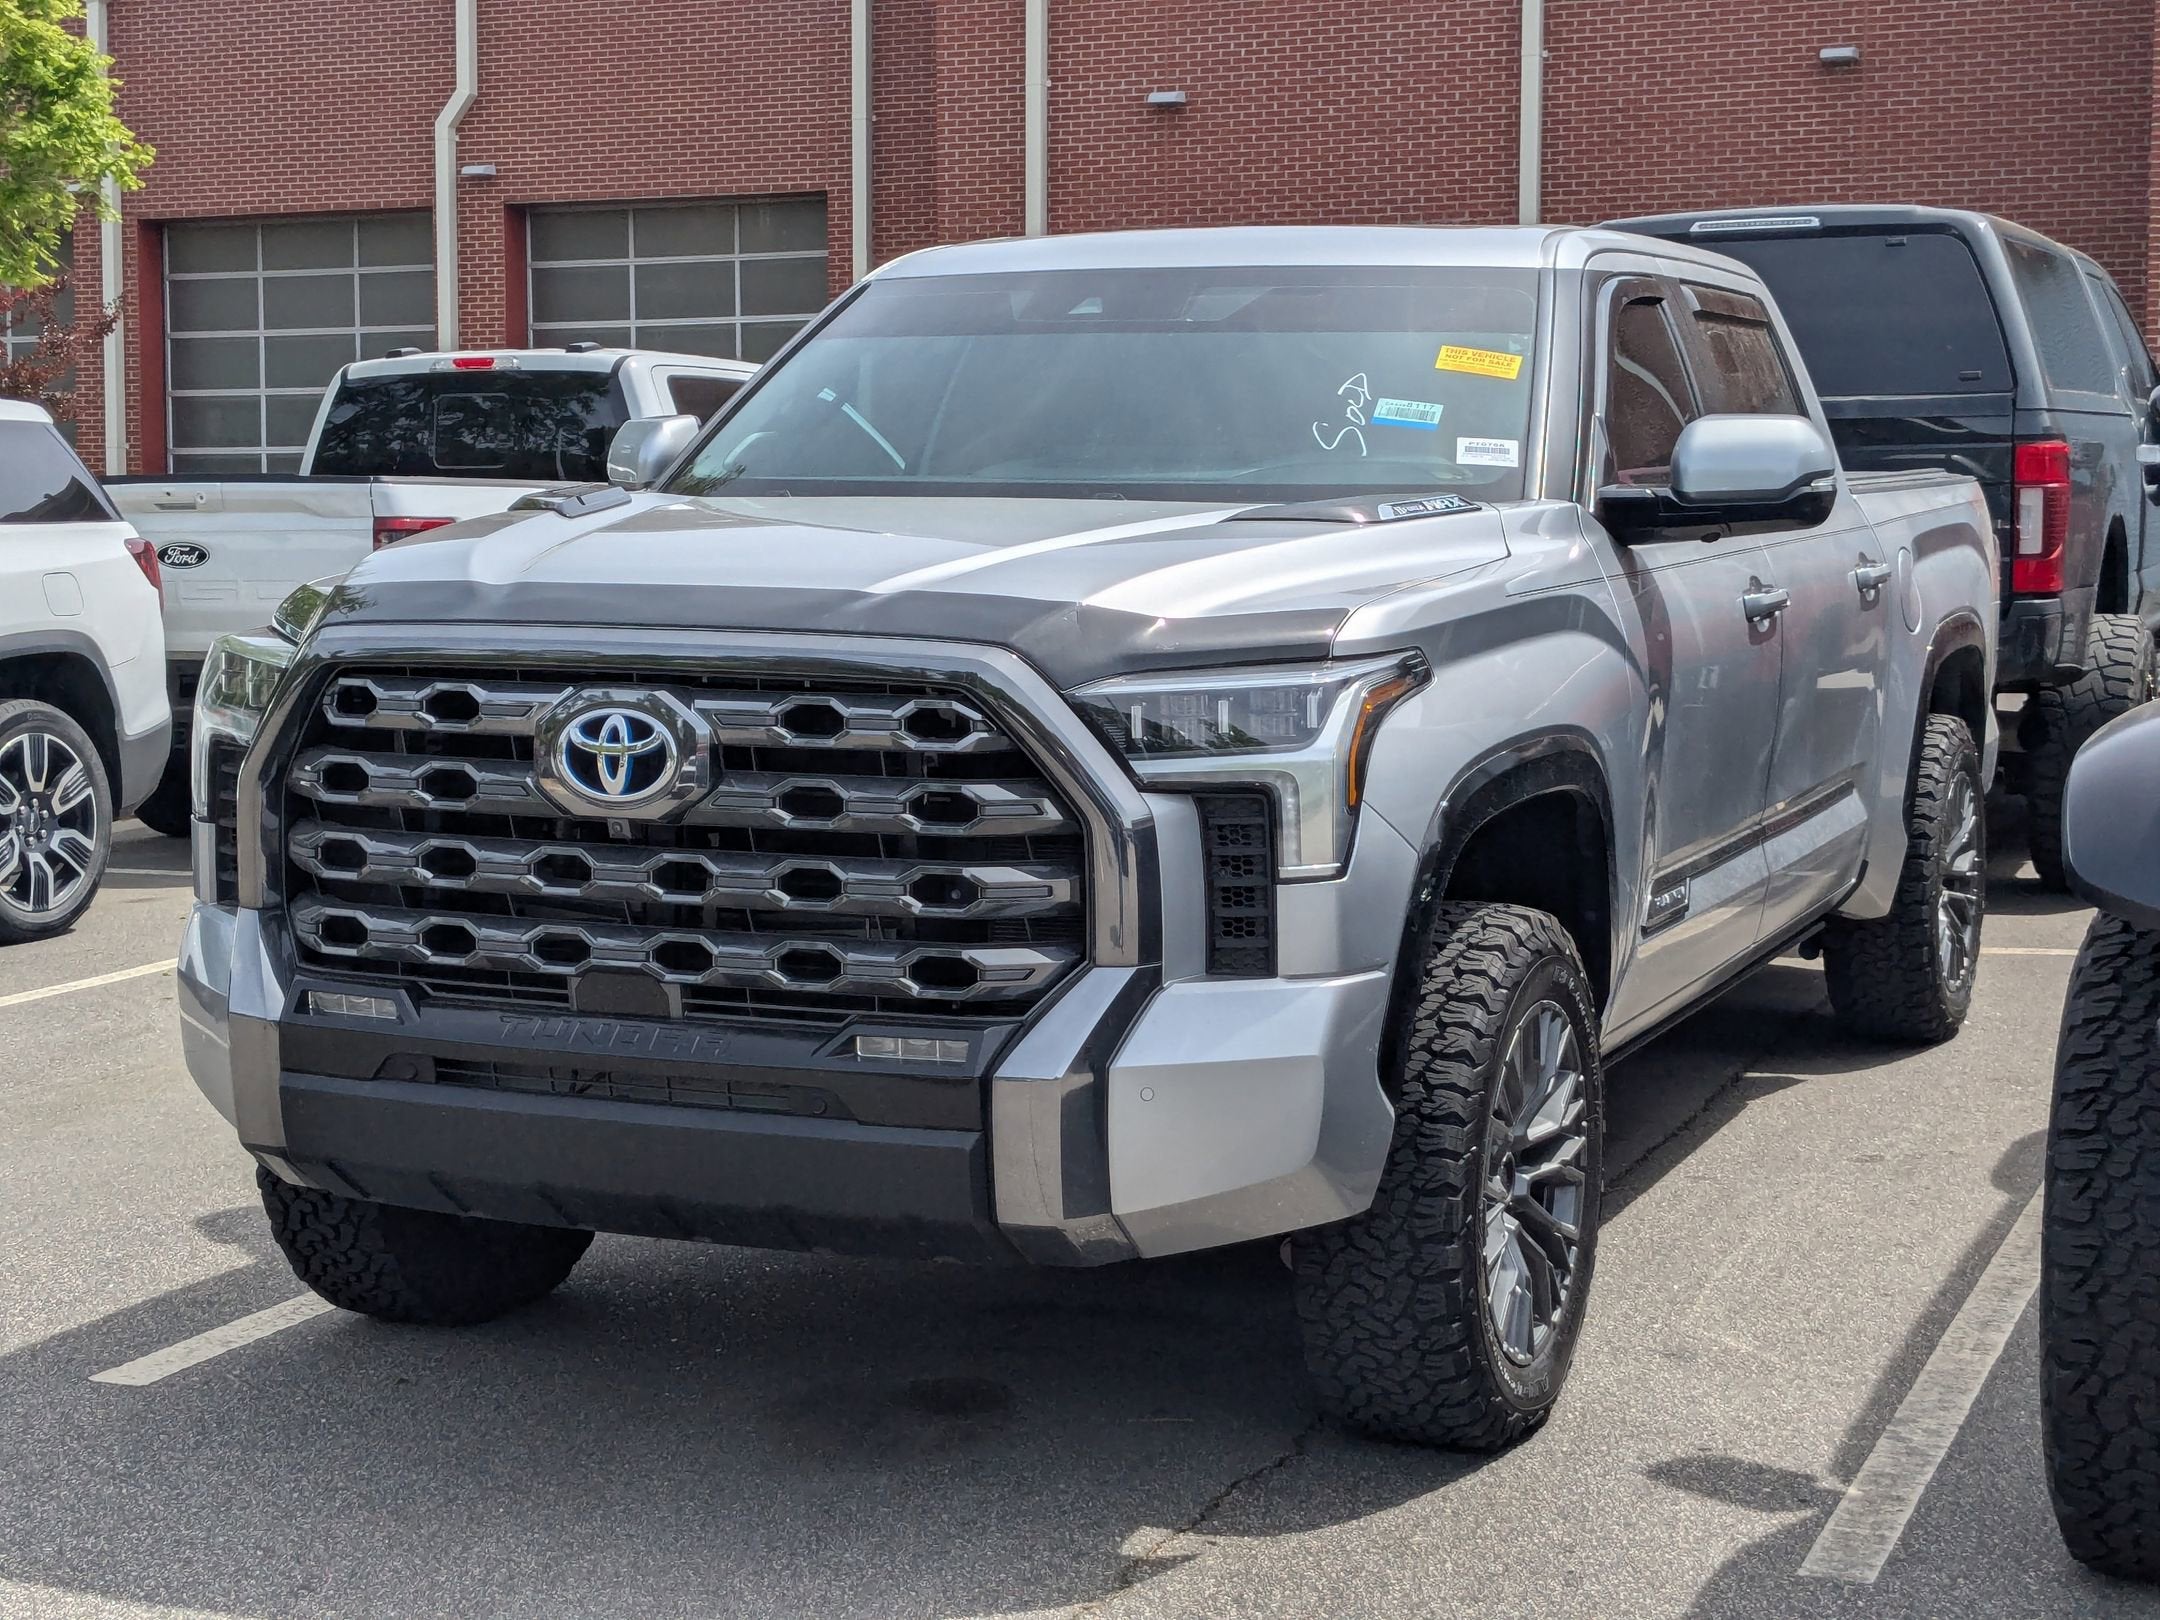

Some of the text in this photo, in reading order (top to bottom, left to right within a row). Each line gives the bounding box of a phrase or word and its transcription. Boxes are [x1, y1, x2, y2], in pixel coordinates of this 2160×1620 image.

[1445, 347, 1517, 363] THIS VEHICLE
[1488, 359, 1513, 367] SALE
[164, 546, 200, 564] Ford
[499, 1014, 733, 1056] TUNDRA
